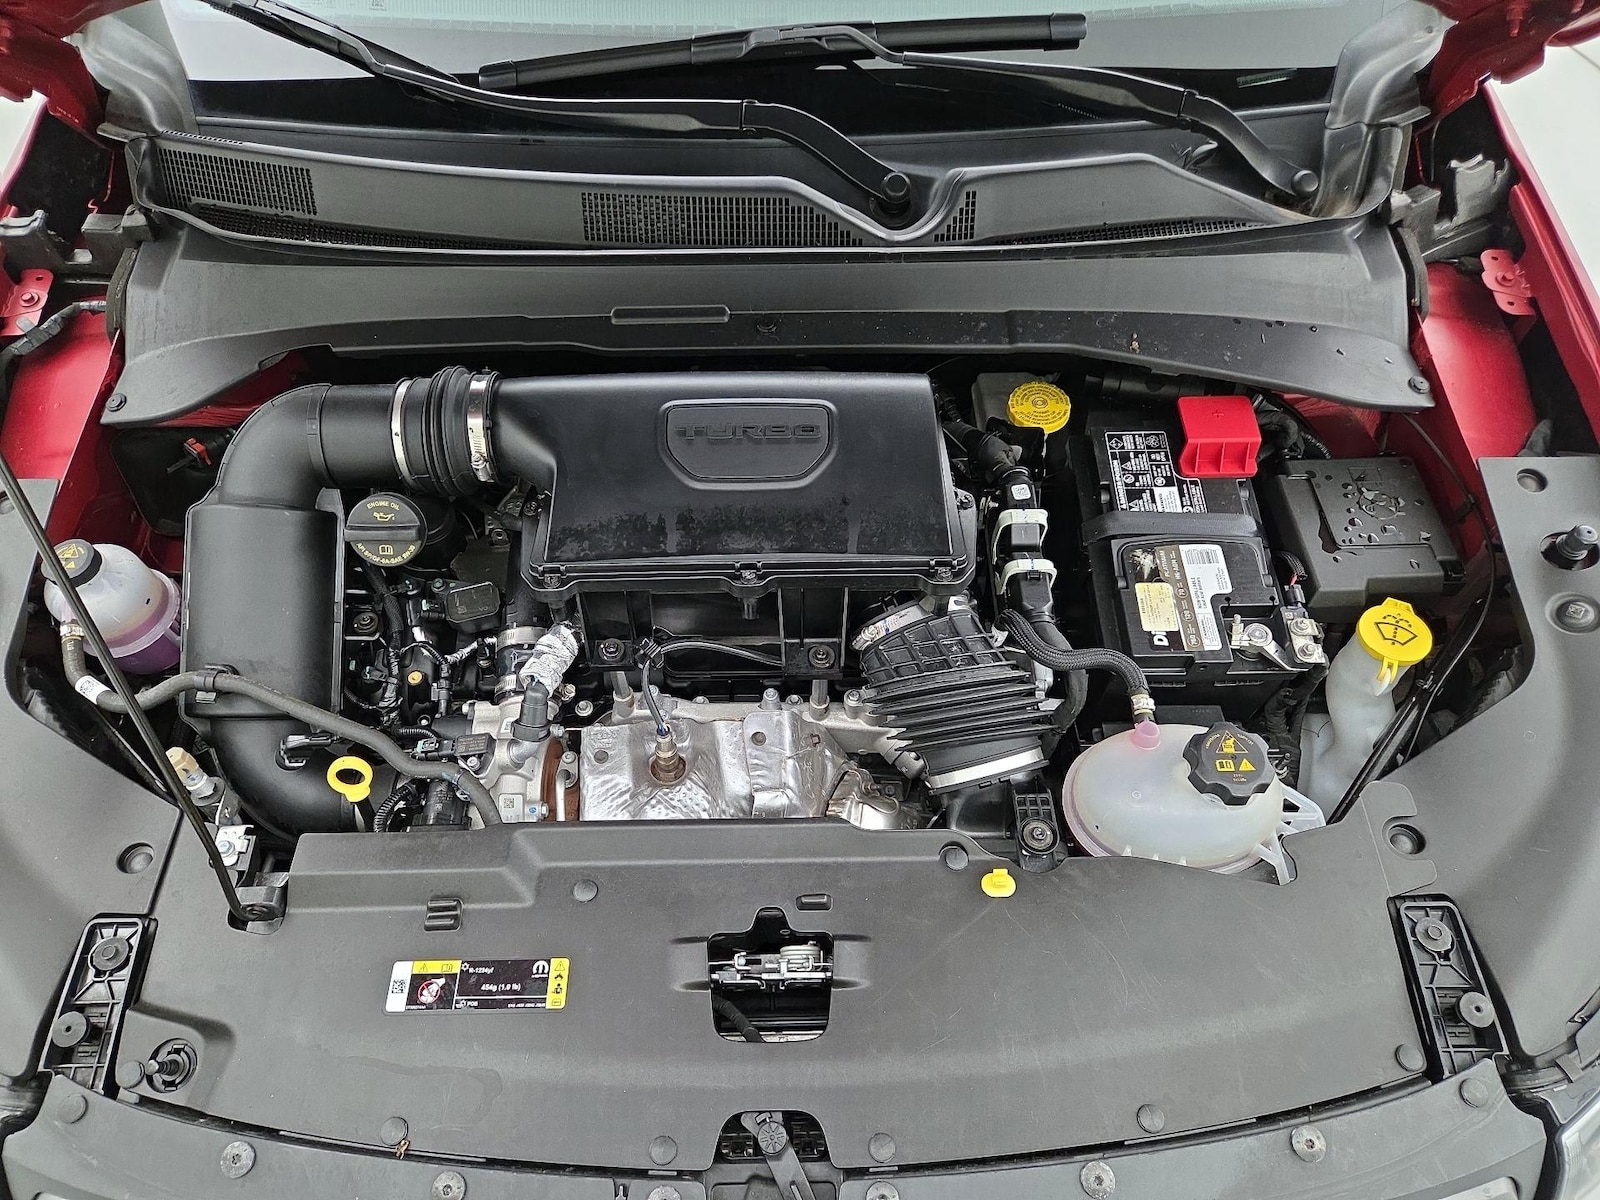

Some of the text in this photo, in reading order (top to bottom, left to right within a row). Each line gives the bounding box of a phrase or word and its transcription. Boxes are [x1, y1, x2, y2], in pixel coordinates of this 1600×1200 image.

[676, 423, 822, 440] TURBO
[366, 501, 400, 510] ENGINE OIL
[356, 543, 366, 553] API
[1159, 550, 1170, 578] PLATINUM
[481, 983, 521, 992] 454g (1.0 lb)
